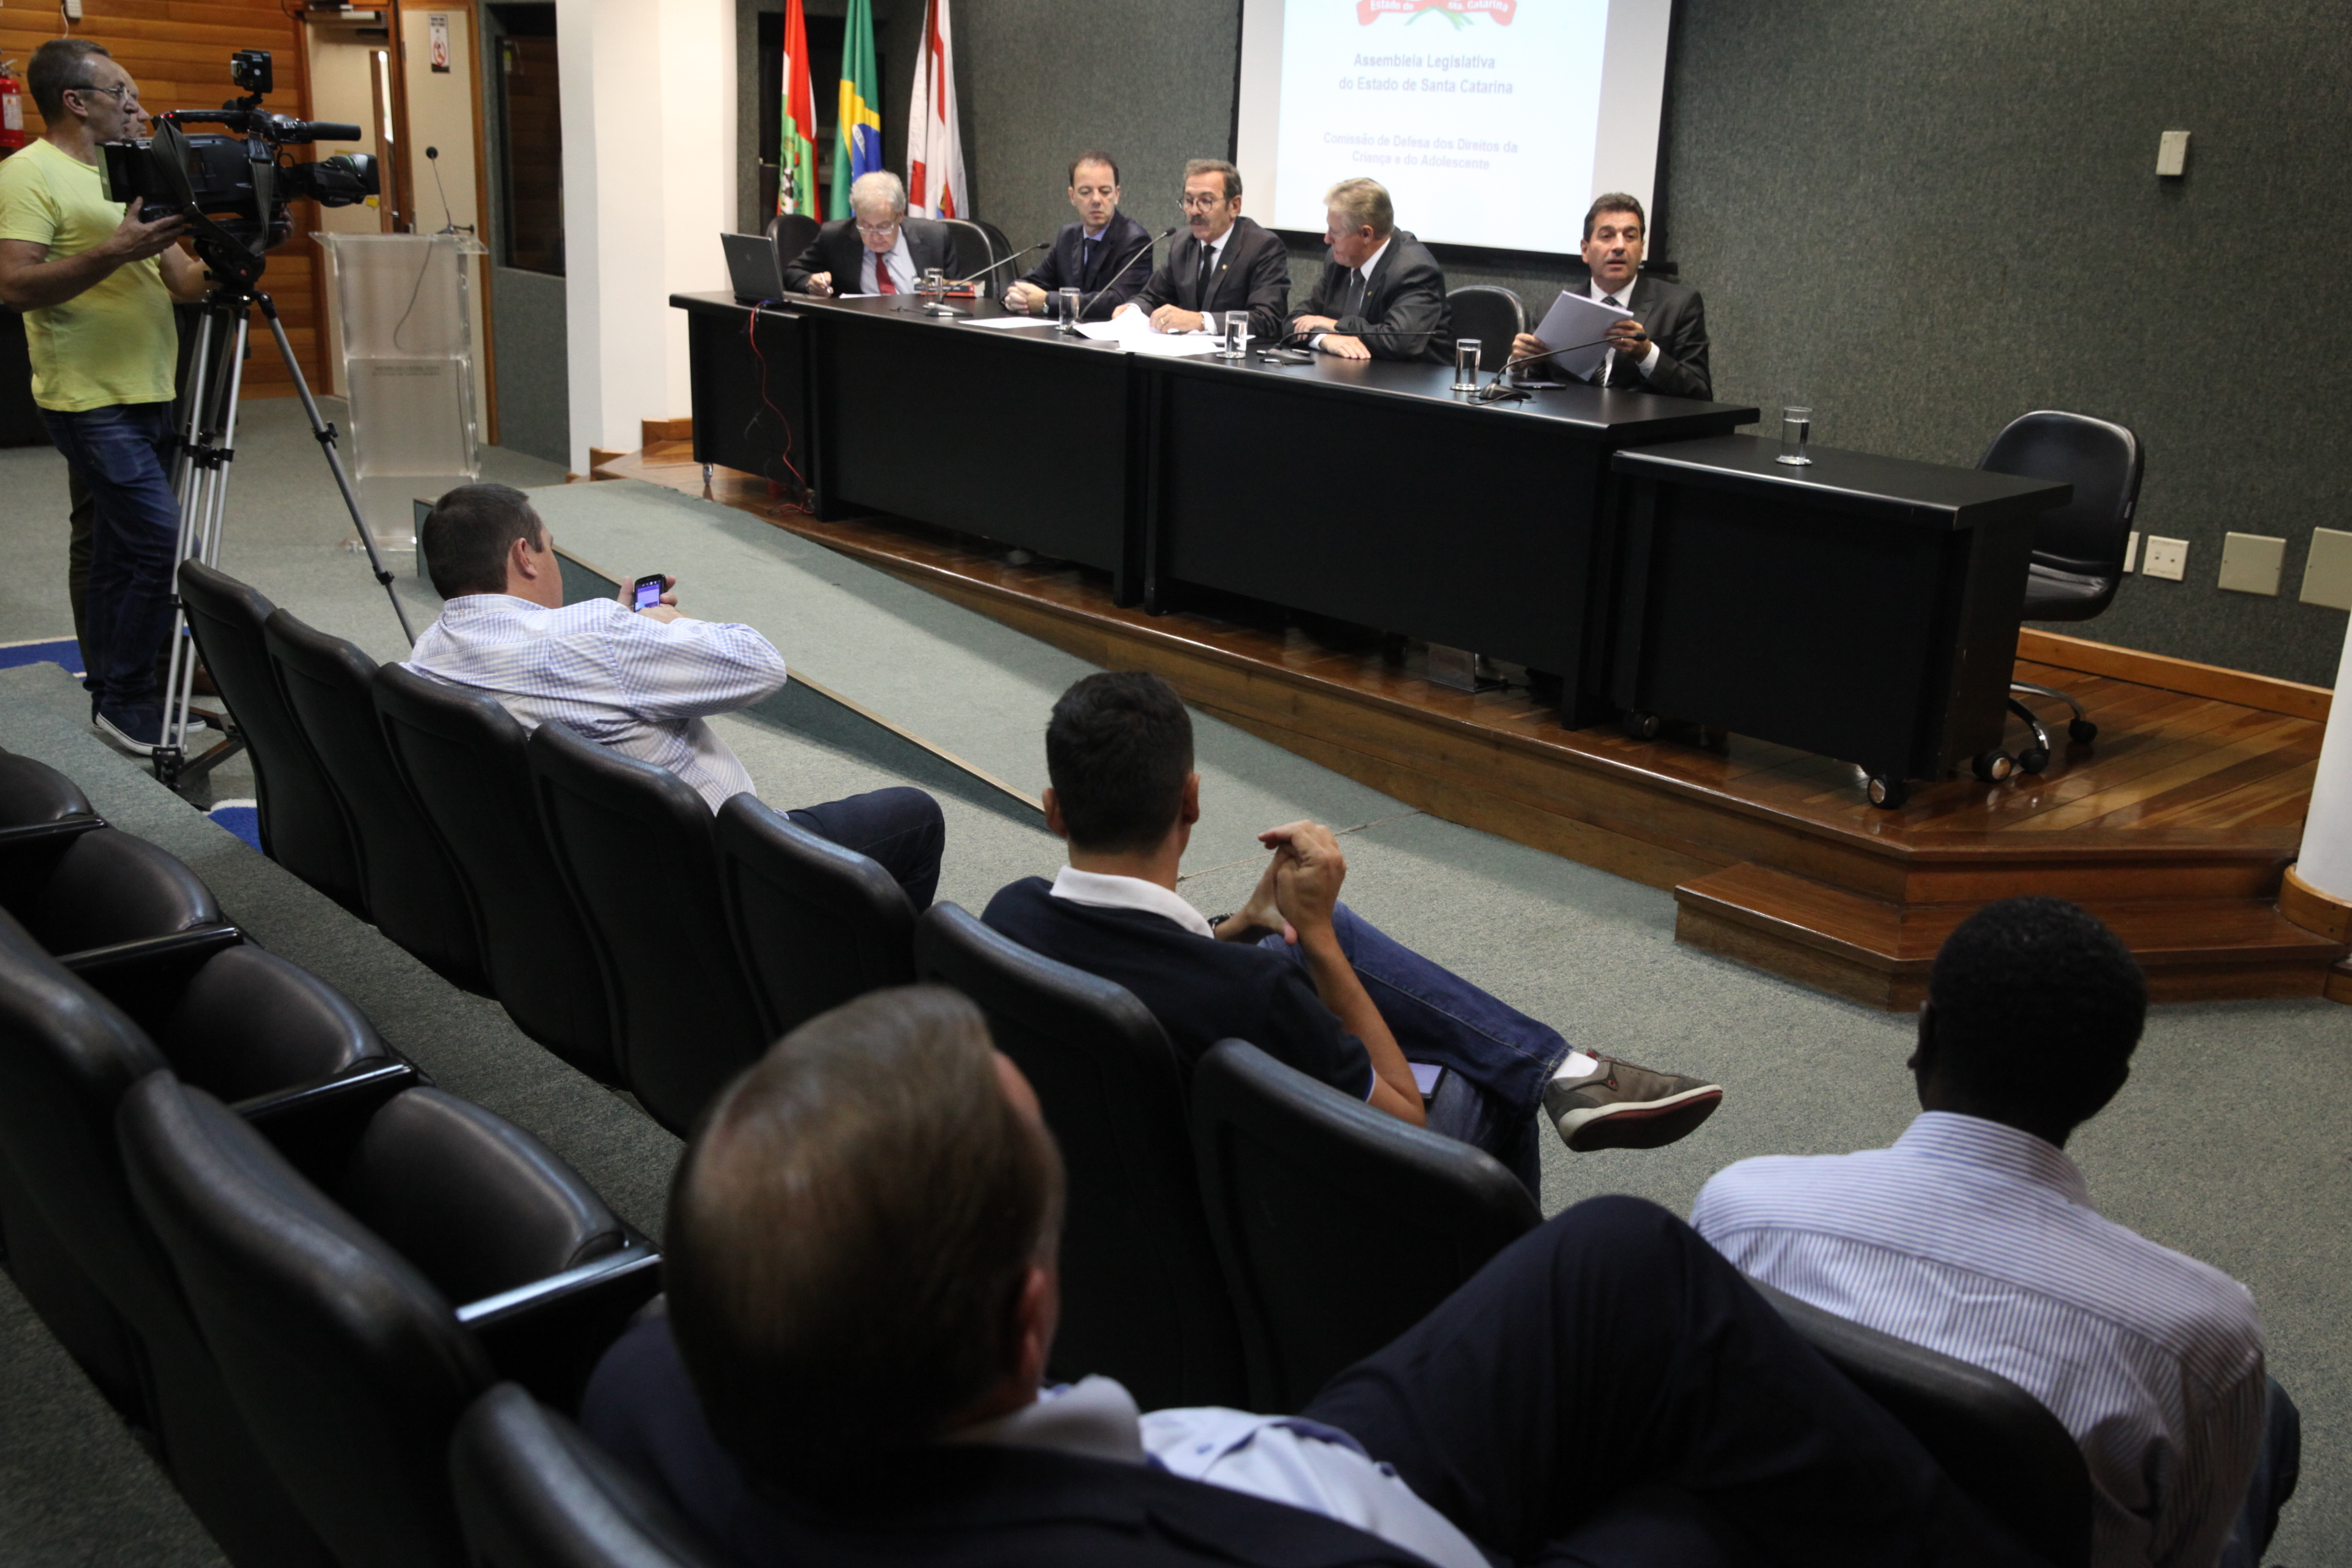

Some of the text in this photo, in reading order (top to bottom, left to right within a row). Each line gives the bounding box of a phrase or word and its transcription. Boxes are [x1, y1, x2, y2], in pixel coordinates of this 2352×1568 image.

[1370, 0, 1401, 11] Estado
[1402, 2, 1414, 11] de
[1467, 0, 1509, 13] Catarina
[1353, 53, 1496, 71] Assembleia Legislativa
[1339, 76, 1514, 95] do Estado de Santa Catarina
[1324, 132, 1519, 154] Comissão de Defesa dos Direitos da
[1352, 150, 1490, 170] Criança e do Adolescente
